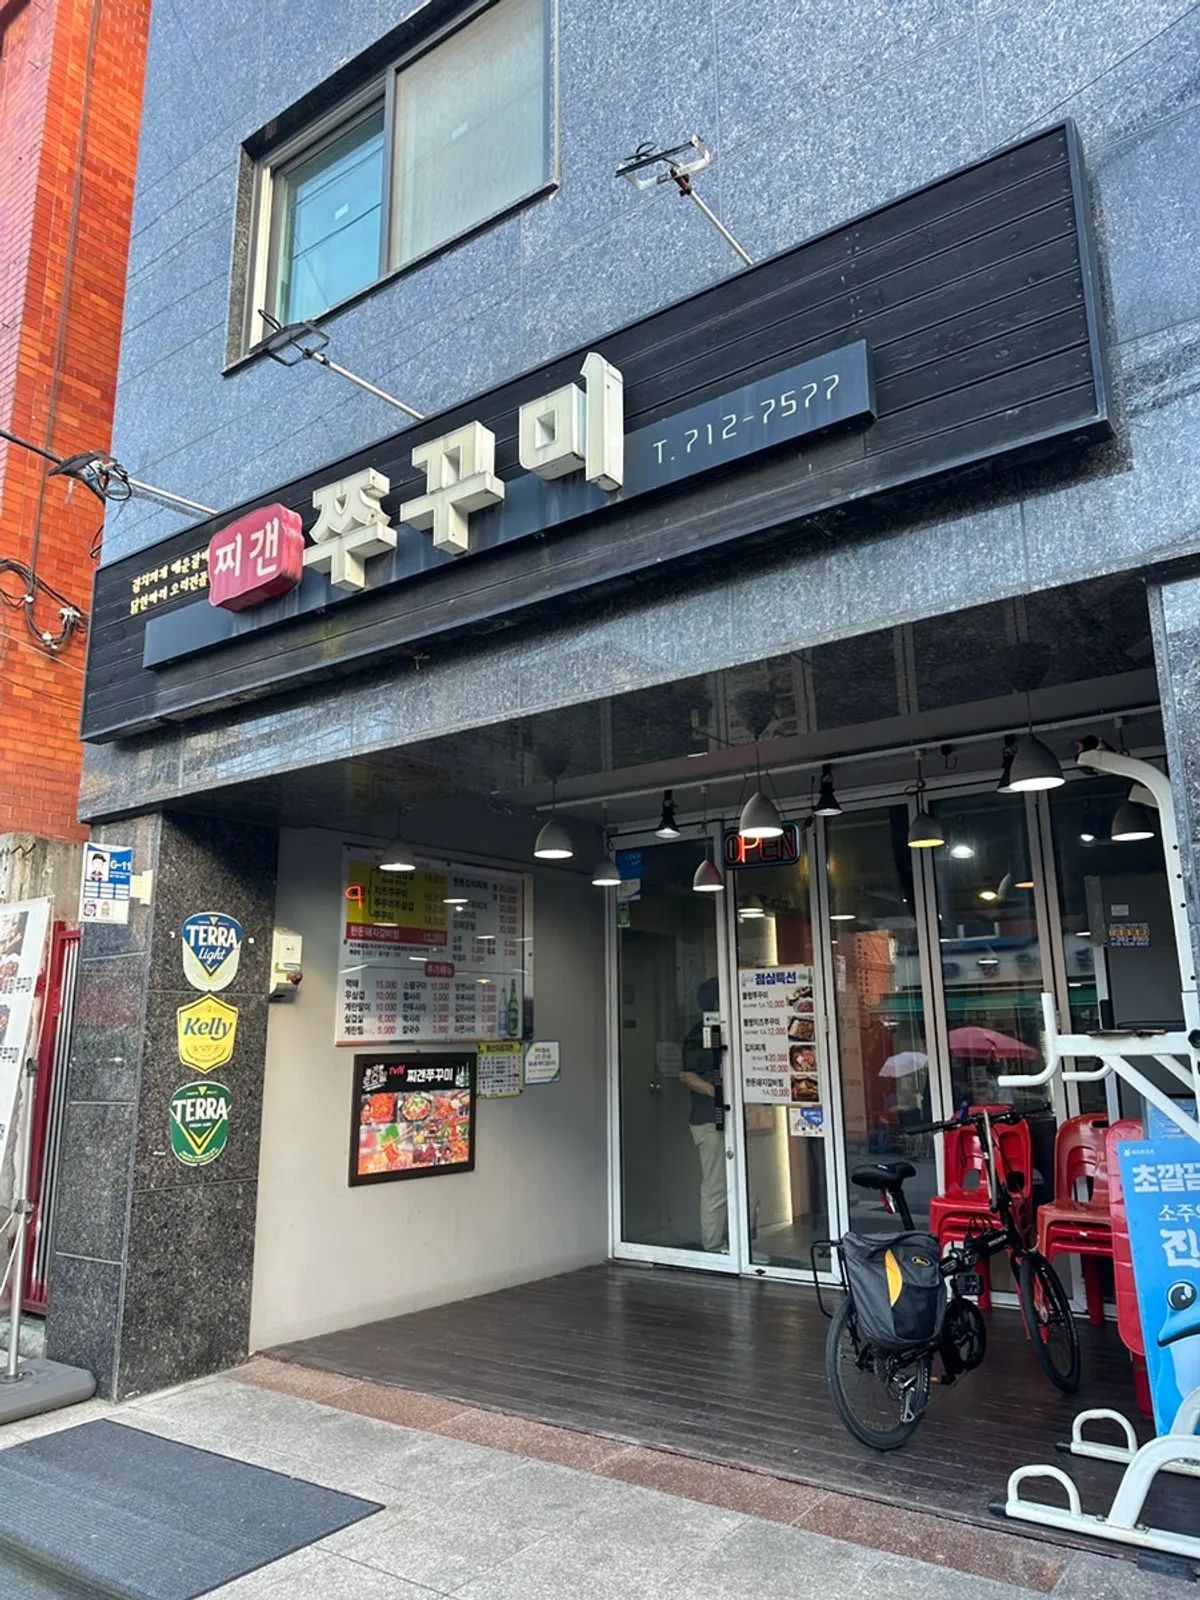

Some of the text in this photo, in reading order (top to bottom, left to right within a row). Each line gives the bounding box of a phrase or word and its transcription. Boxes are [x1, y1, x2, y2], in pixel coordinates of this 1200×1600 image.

[725, 830, 796, 863] OPEN
[186, 924, 238, 949] TERRA
[199, 947, 226, 964] Light
[755, 971, 797, 985] 점심특선
[183, 1016, 234, 1041] Kelly
[171, 1096, 229, 1123] TERRA
[1157, 1203, 1200, 1223] 소주
